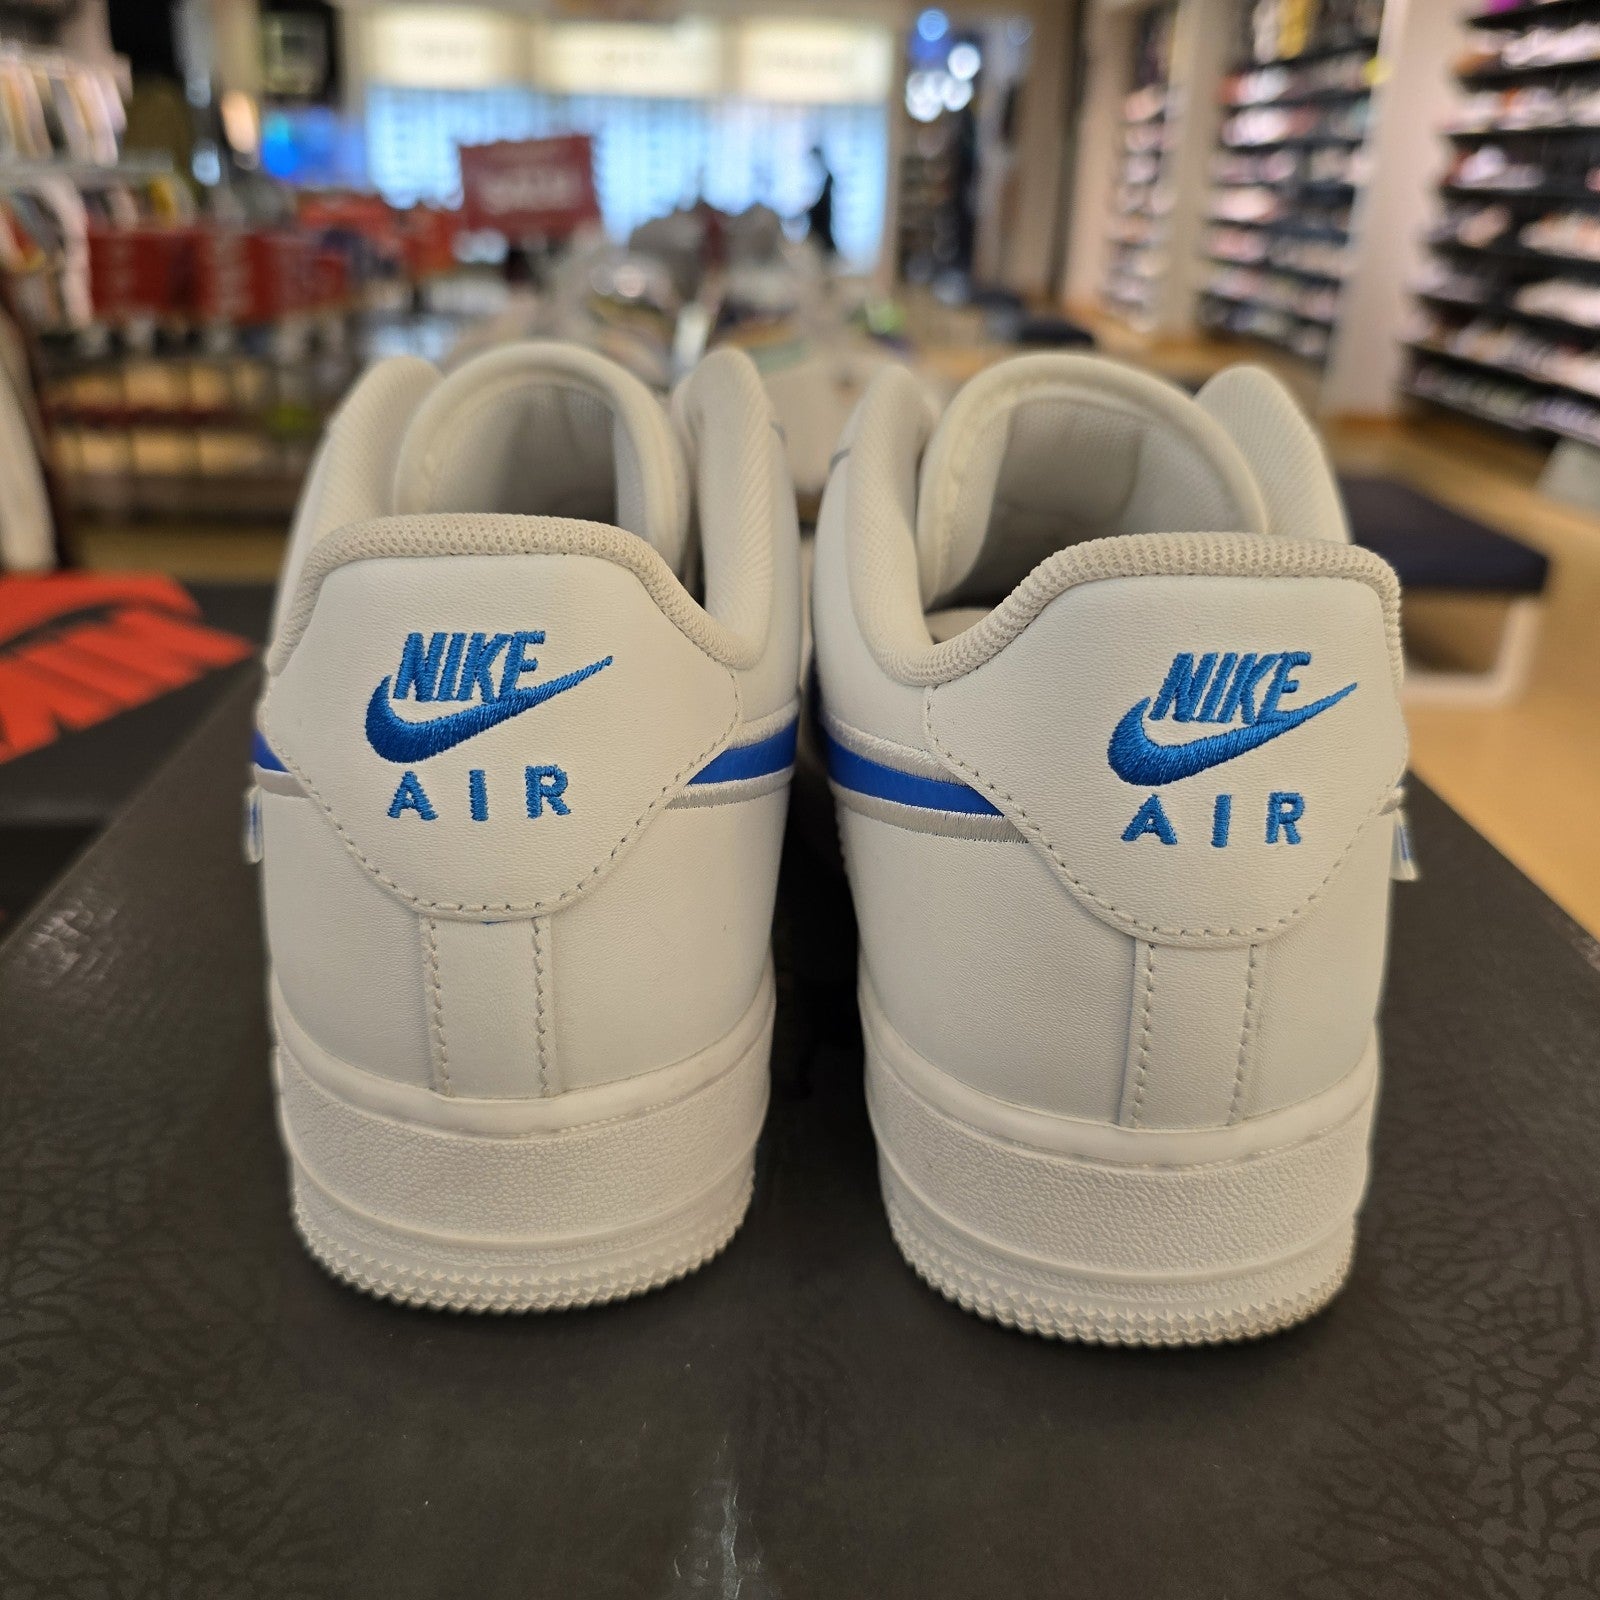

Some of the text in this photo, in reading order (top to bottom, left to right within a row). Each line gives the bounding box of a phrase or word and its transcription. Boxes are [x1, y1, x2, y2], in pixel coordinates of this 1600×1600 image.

[393, 631, 546, 703] NIKE
[1148, 651, 1311, 725] NIKE
[387, 764, 571, 821] AIR
[1121, 791, 1305, 848] AIR
